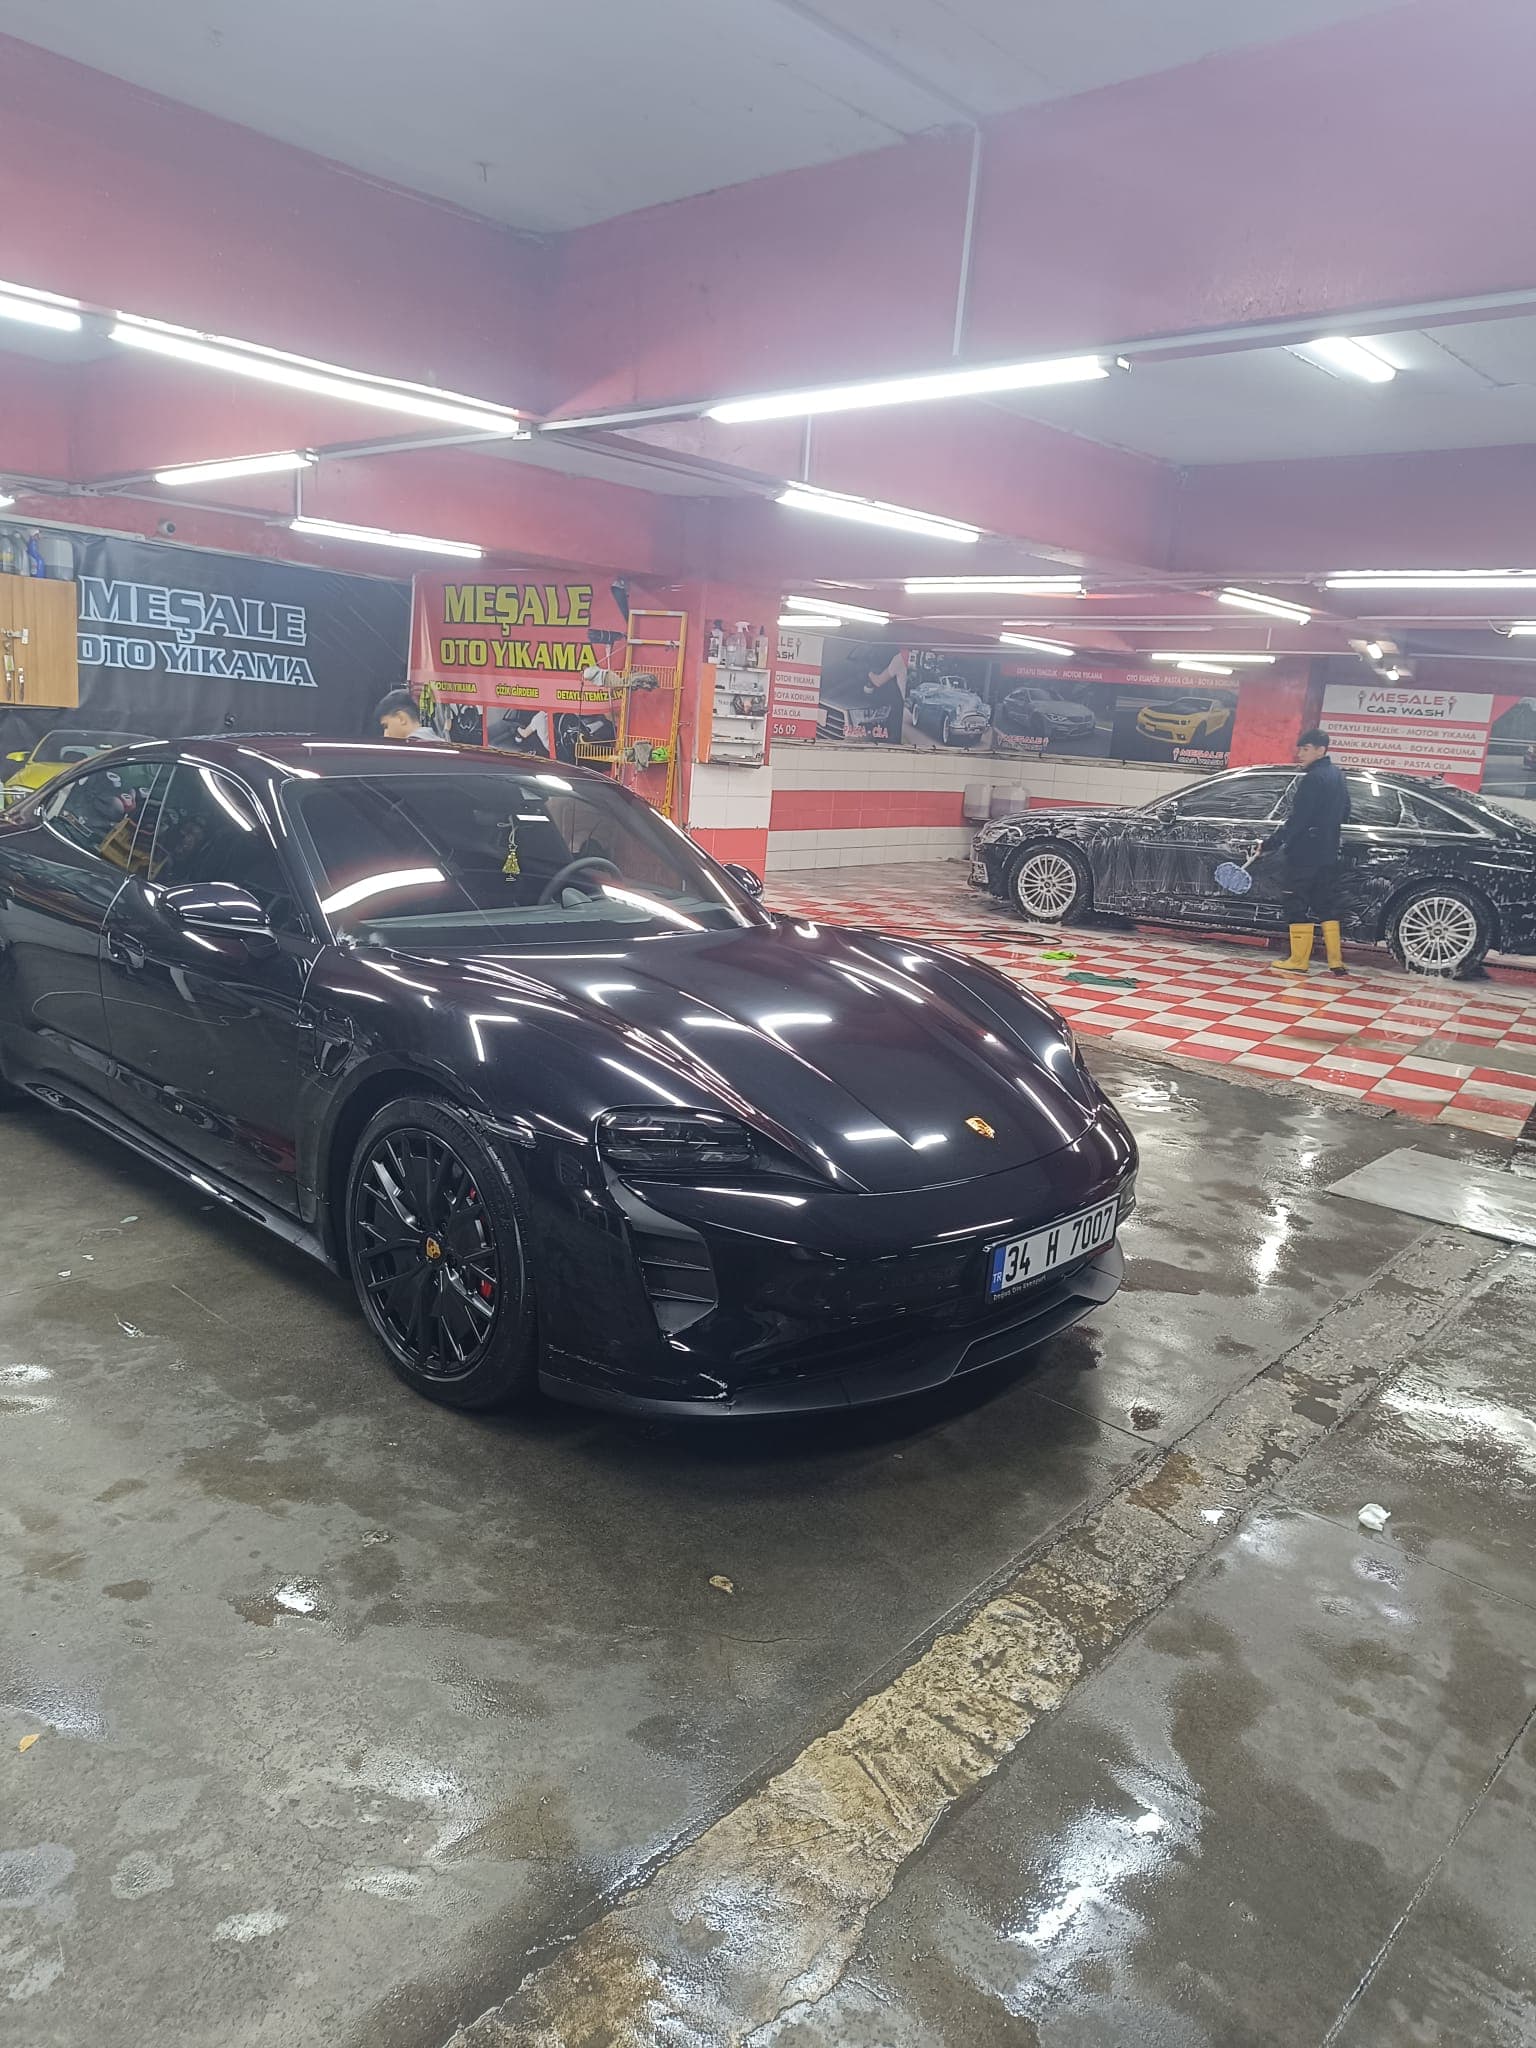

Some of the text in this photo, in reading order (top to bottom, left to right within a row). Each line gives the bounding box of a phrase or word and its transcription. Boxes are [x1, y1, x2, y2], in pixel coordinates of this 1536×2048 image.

[78, 575, 307, 646] MEŞALE
[444, 584, 592, 635] MEŞALE
[76, 633, 319, 688] OTO YIKAMA
[440, 639, 598, 672] OTO YIKAMA
[776, 691, 789, 701] OYA
[1369, 692, 1445, 707] MEŞALE
[773, 708, 788, 717] ASTA
[1367, 705, 1445, 718] CAR WASH
[785, 724, 797, 735] 09
[1328, 723, 1360, 733] DETAYLI
[1406, 729, 1439, 738] MOTOR
[1442, 731, 1477, 740] YIKAMA
[1329, 738, 1477, 757] ERAMİK KAPLAMA BOYA KORUMA
[1340, 755, 1360, 764] OTO
[1361, 756, 1396, 767] KUAFÖR
[1404, 760, 1431, 769] PASTA
[992, 1205, 1114, 1284] TR 34 H 7007
